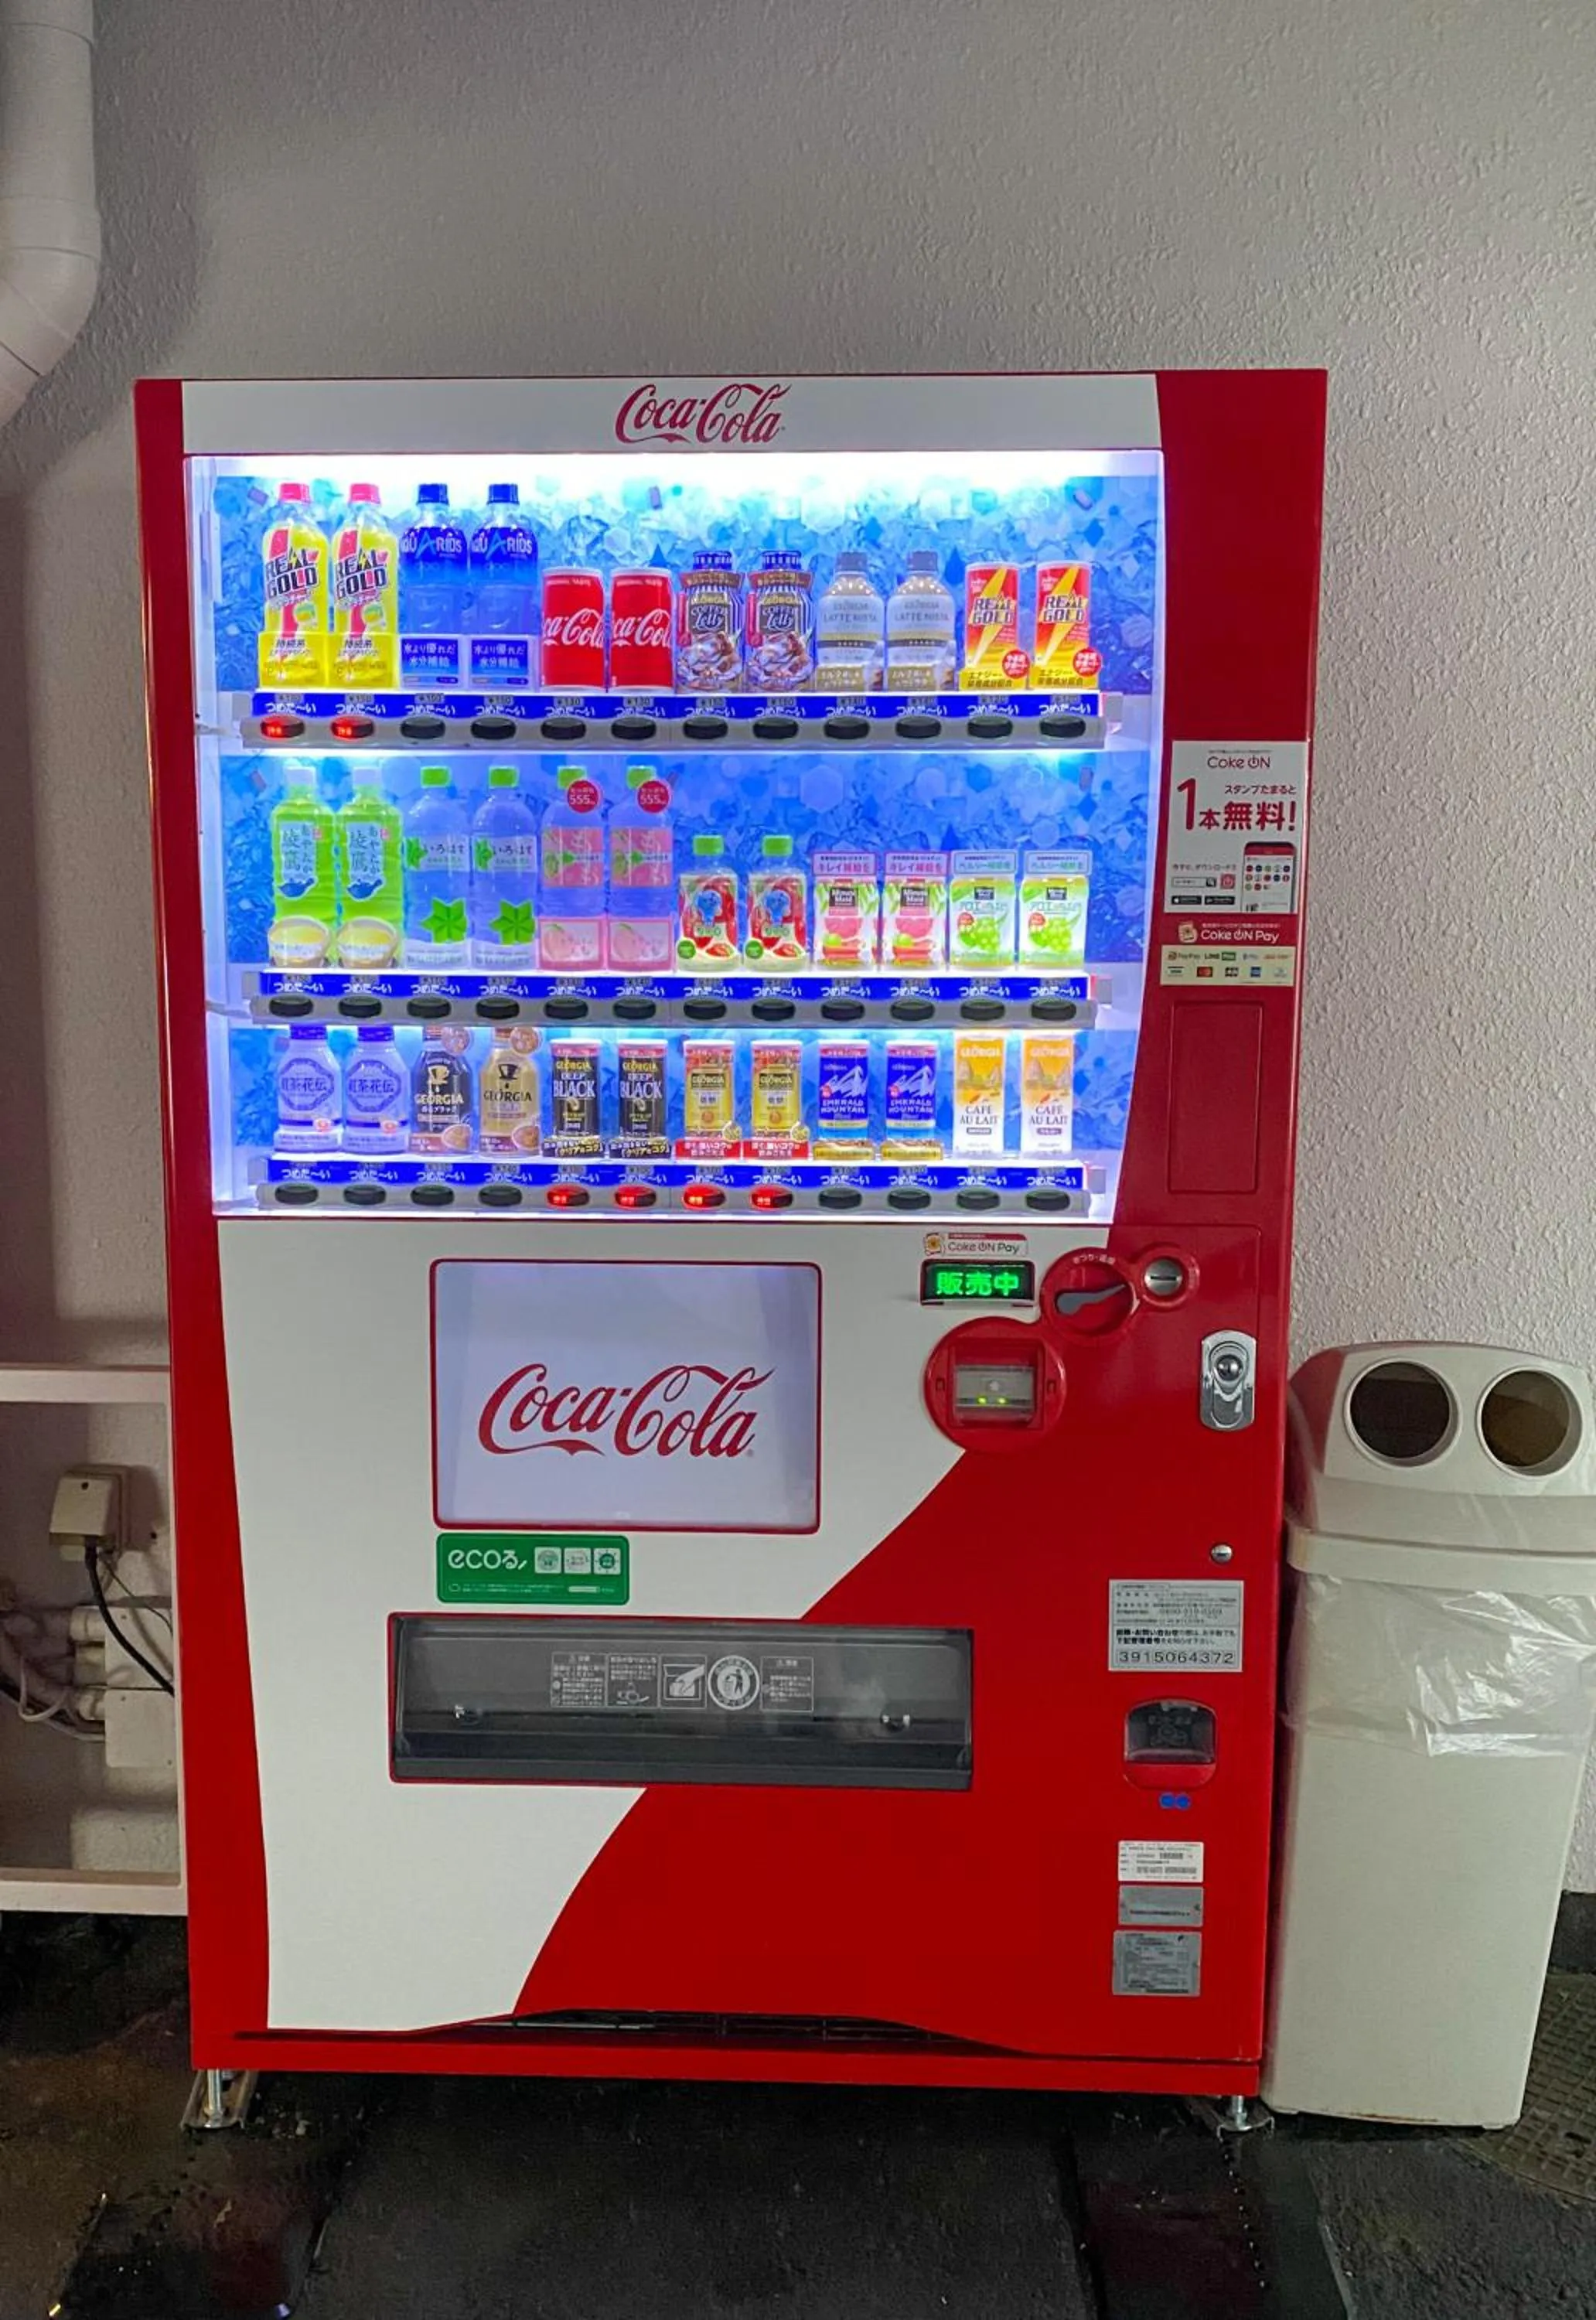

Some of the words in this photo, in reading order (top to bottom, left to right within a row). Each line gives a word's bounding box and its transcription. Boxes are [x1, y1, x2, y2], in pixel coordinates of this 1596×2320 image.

[616, 384, 792, 444] Coca-Cola
[265, 548, 318, 578] REAL
[335, 548, 387, 578] REAL
[268, 566, 318, 598] GOLD
[336, 567, 387, 599] GOLD
[973, 610, 1013, 623] GOLD
[1044, 609, 1084, 622] GOLD
[1207, 756, 1244, 769] Coke
[1225, 785, 1297, 795] スタンプたまると
[1200, 930, 1231, 940] Coke
[1255, 930, 1280, 944] Pay
[483, 1089, 532, 1102] GEORGIA
[554, 1080, 596, 1098] BLACK
[620, 1080, 663, 1098] BLACK
[414, 1093, 464, 1104] GEORGIA
[960, 1116, 973, 1124] AU
[1030, 1116, 1043, 1124] AU
[948, 1242, 977, 1252] Coke
[997, 1243, 1020, 1254] Pay
[936, 1271, 1019, 1296] 販売中
[478, 1363, 776, 1459] Coca-Cola
[1120, 1651, 1233, 1663] 3915064372
